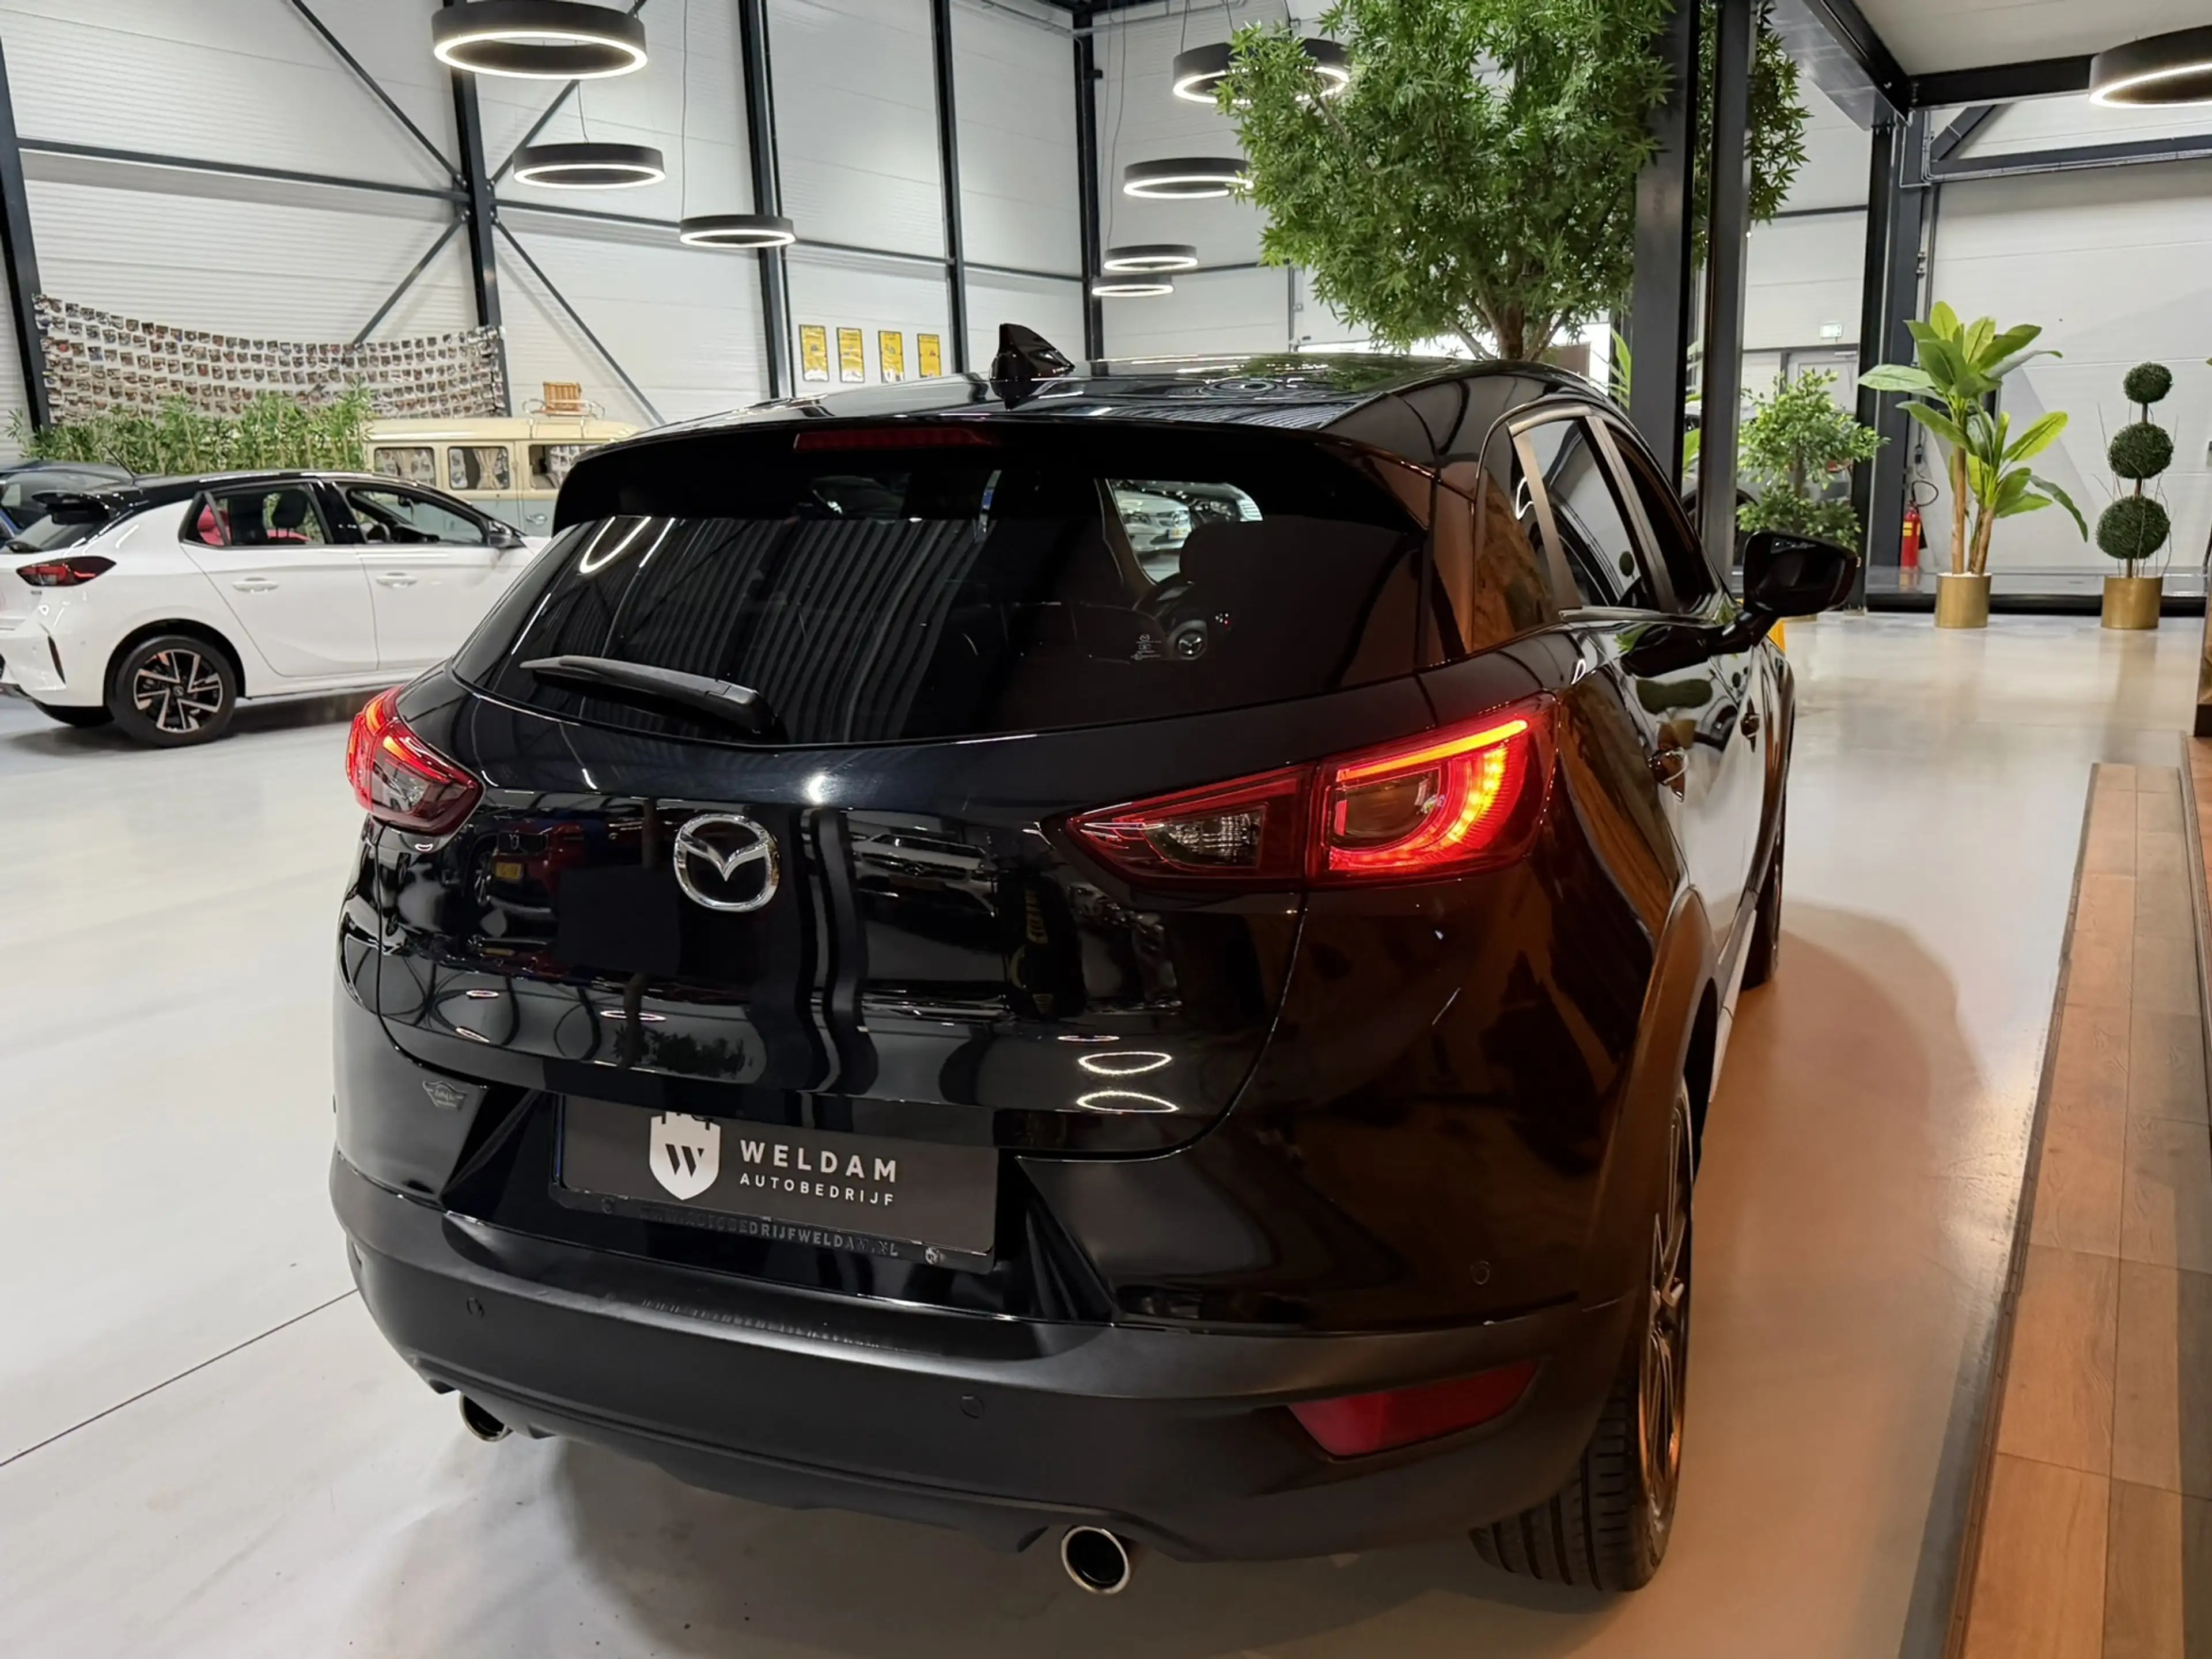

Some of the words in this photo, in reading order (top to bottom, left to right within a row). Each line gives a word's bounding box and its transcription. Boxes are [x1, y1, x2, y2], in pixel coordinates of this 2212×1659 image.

[665, 1143, 705, 1179] W
[740, 1139, 896, 1183] WELDAM
[740, 1172, 893, 1206] AUTOBEDRIJF
